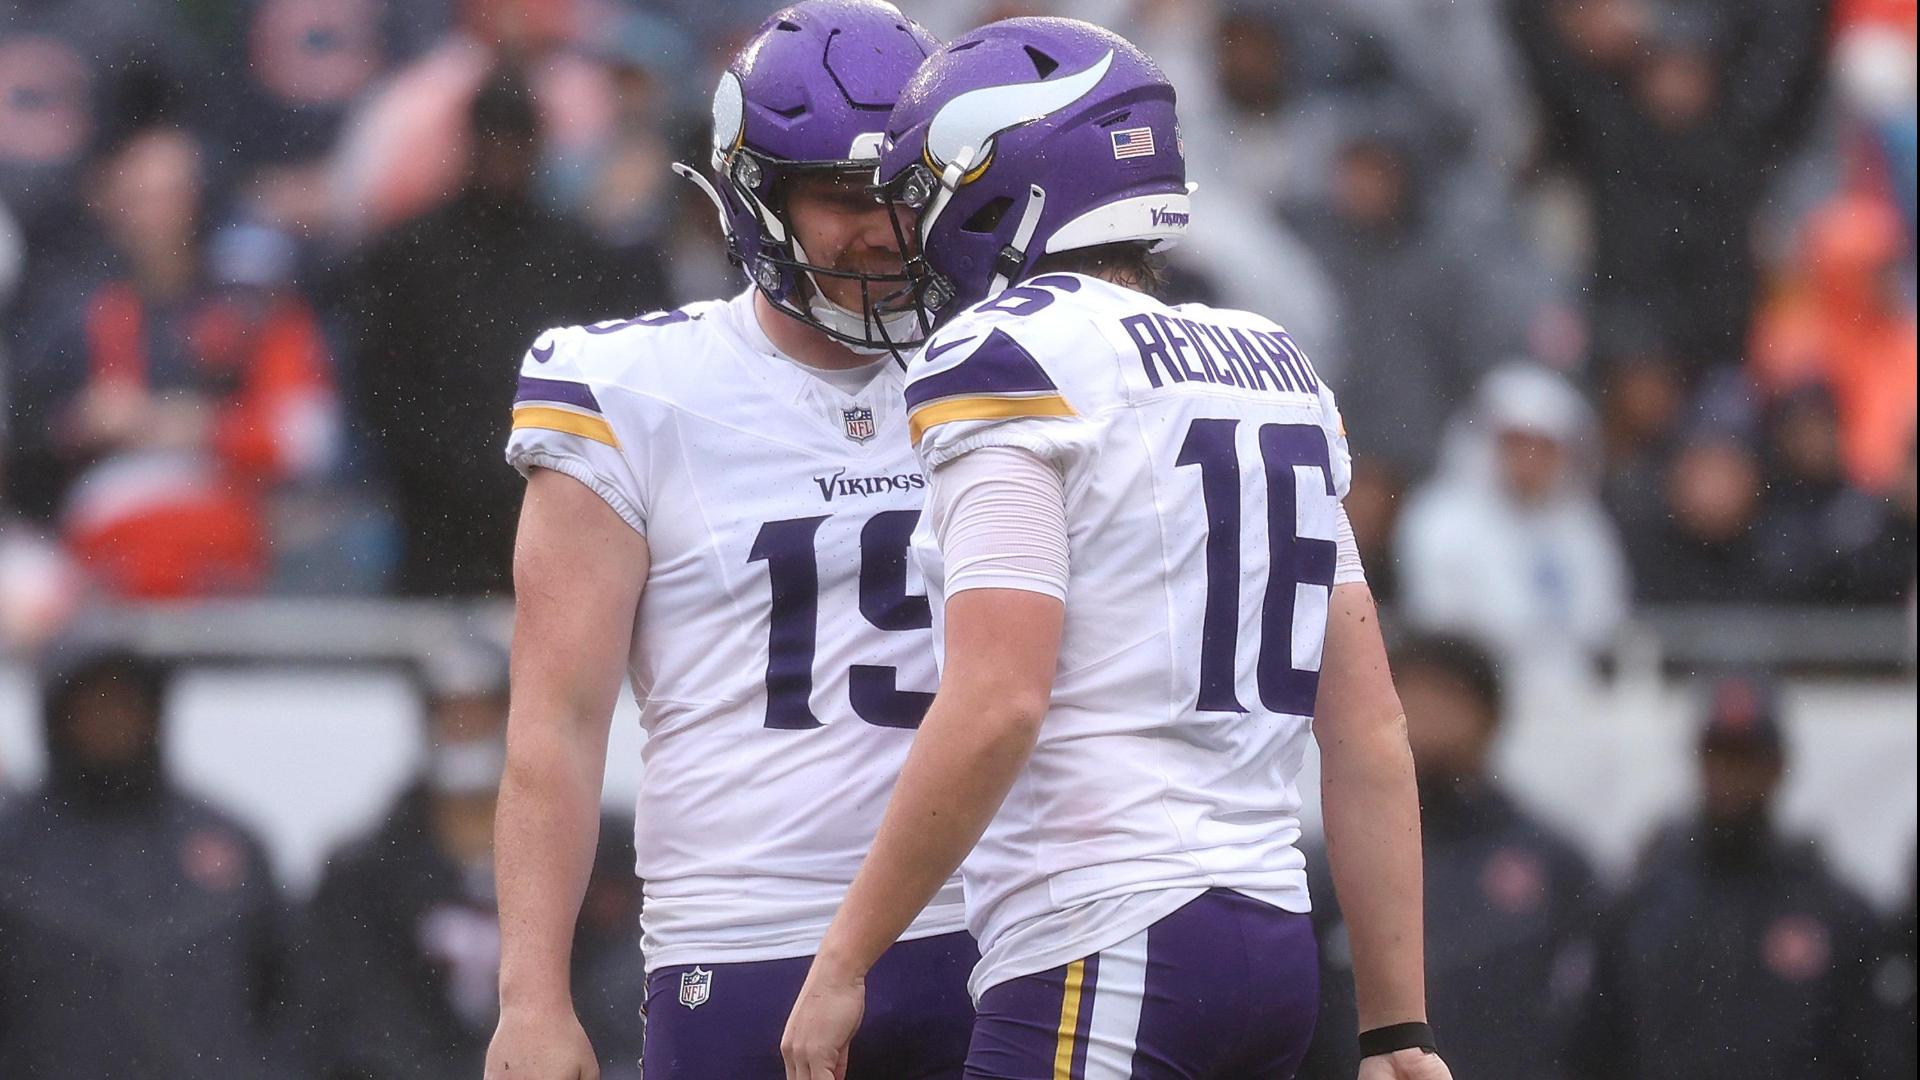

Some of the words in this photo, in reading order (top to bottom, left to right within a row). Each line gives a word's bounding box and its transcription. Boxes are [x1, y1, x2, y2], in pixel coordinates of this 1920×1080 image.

[1119, 312, 1320, 397] REICHARD
[848, 420, 873, 435] NFL
[1175, 418, 1337, 717] 16
[746, 509, 940, 729] 19
[683, 985, 704, 1001] NFL
